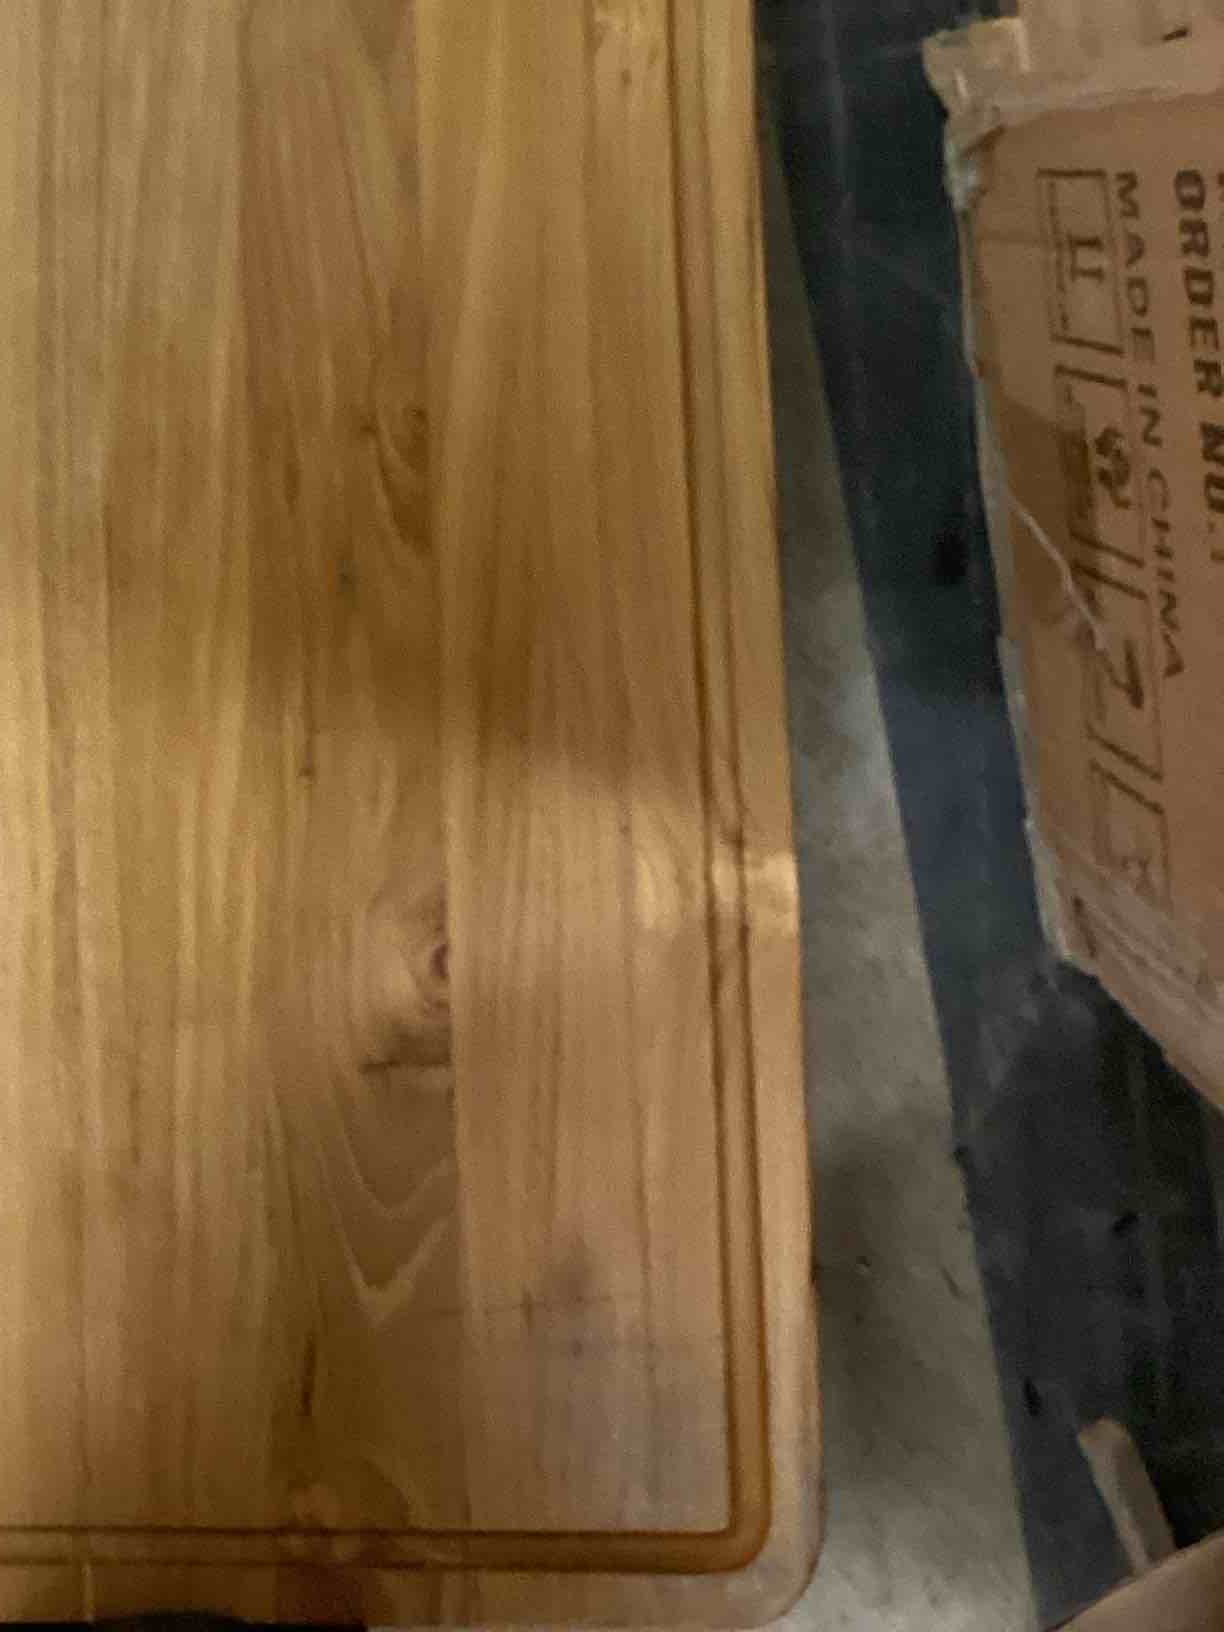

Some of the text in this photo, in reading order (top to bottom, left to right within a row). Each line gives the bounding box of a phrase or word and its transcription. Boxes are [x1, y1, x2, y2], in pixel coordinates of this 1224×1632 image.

[1114, 171, 1185, 678] MADE IN CHINA
[1174, 169, 1224, 397] ORDER
